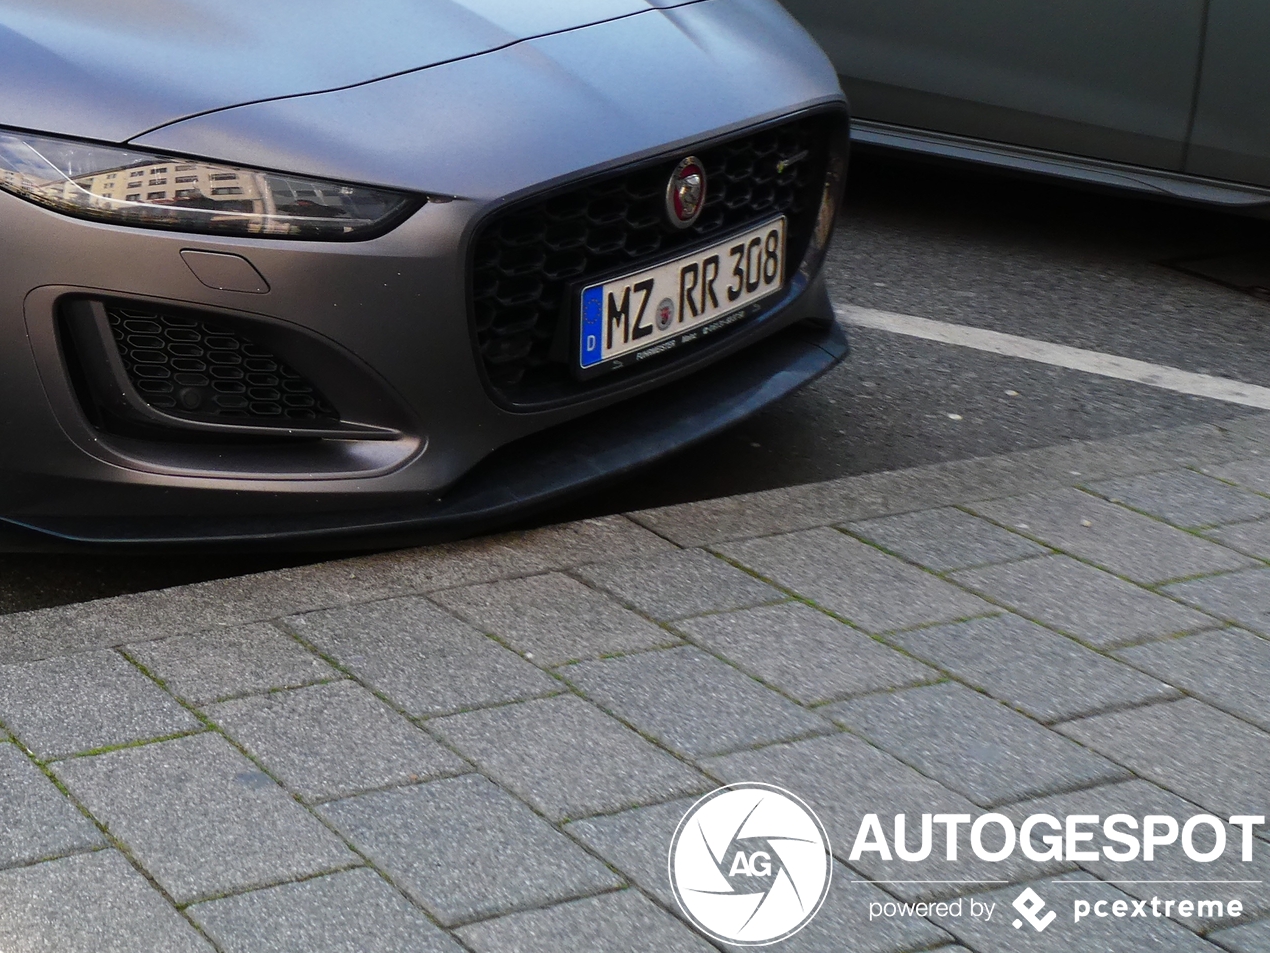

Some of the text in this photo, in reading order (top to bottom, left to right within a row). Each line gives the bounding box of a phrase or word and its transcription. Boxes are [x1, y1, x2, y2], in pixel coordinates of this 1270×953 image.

[606, 229, 779, 350] MZ RR 308
[586, 335, 596, 352] D
